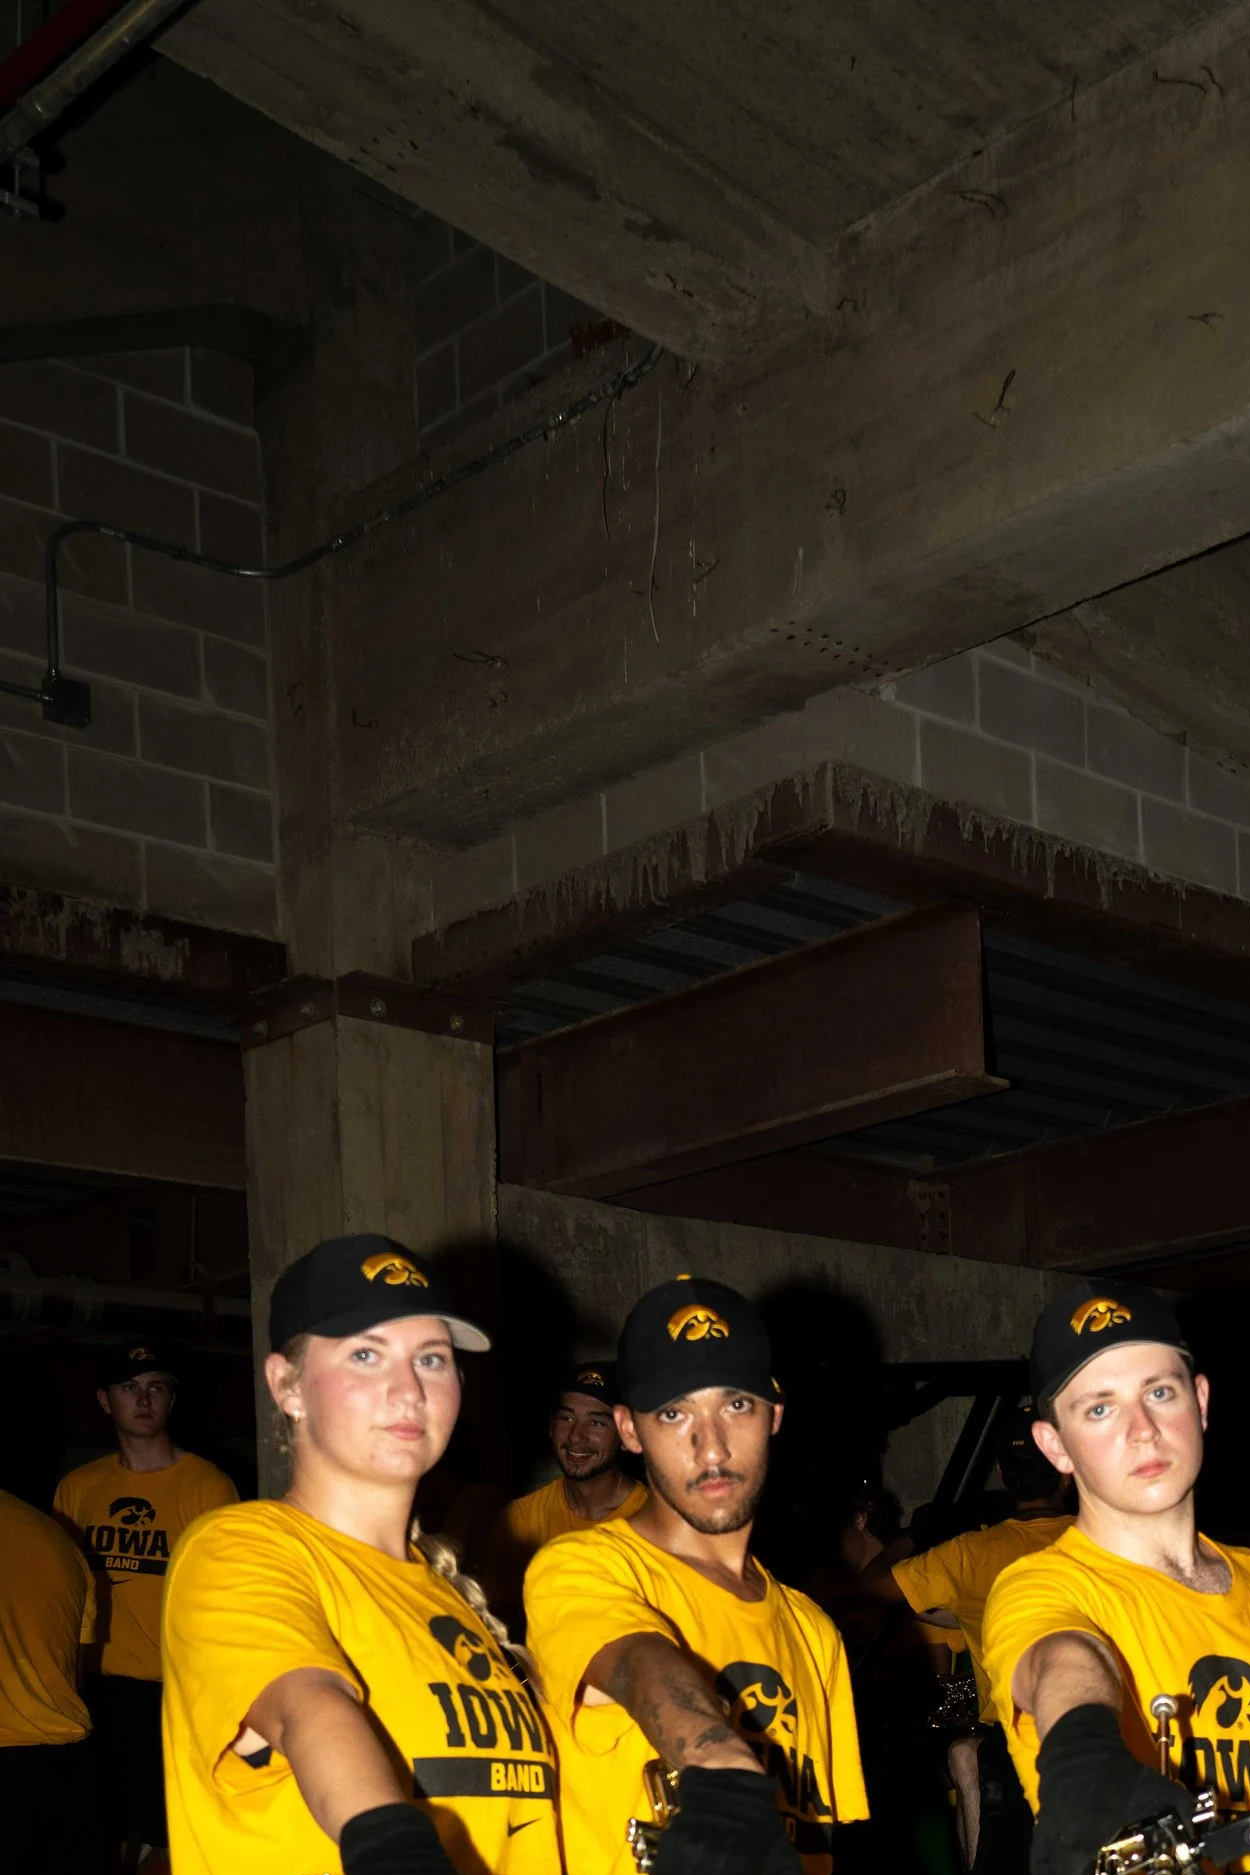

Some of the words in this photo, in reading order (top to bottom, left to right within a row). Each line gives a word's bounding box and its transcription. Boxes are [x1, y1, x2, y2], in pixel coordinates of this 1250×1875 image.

[84, 1525, 170, 1557] IOWA
[105, 1557, 139, 1570] BAND
[428, 1682, 552, 1757] IOW
[491, 1762, 545, 1793] BAND
